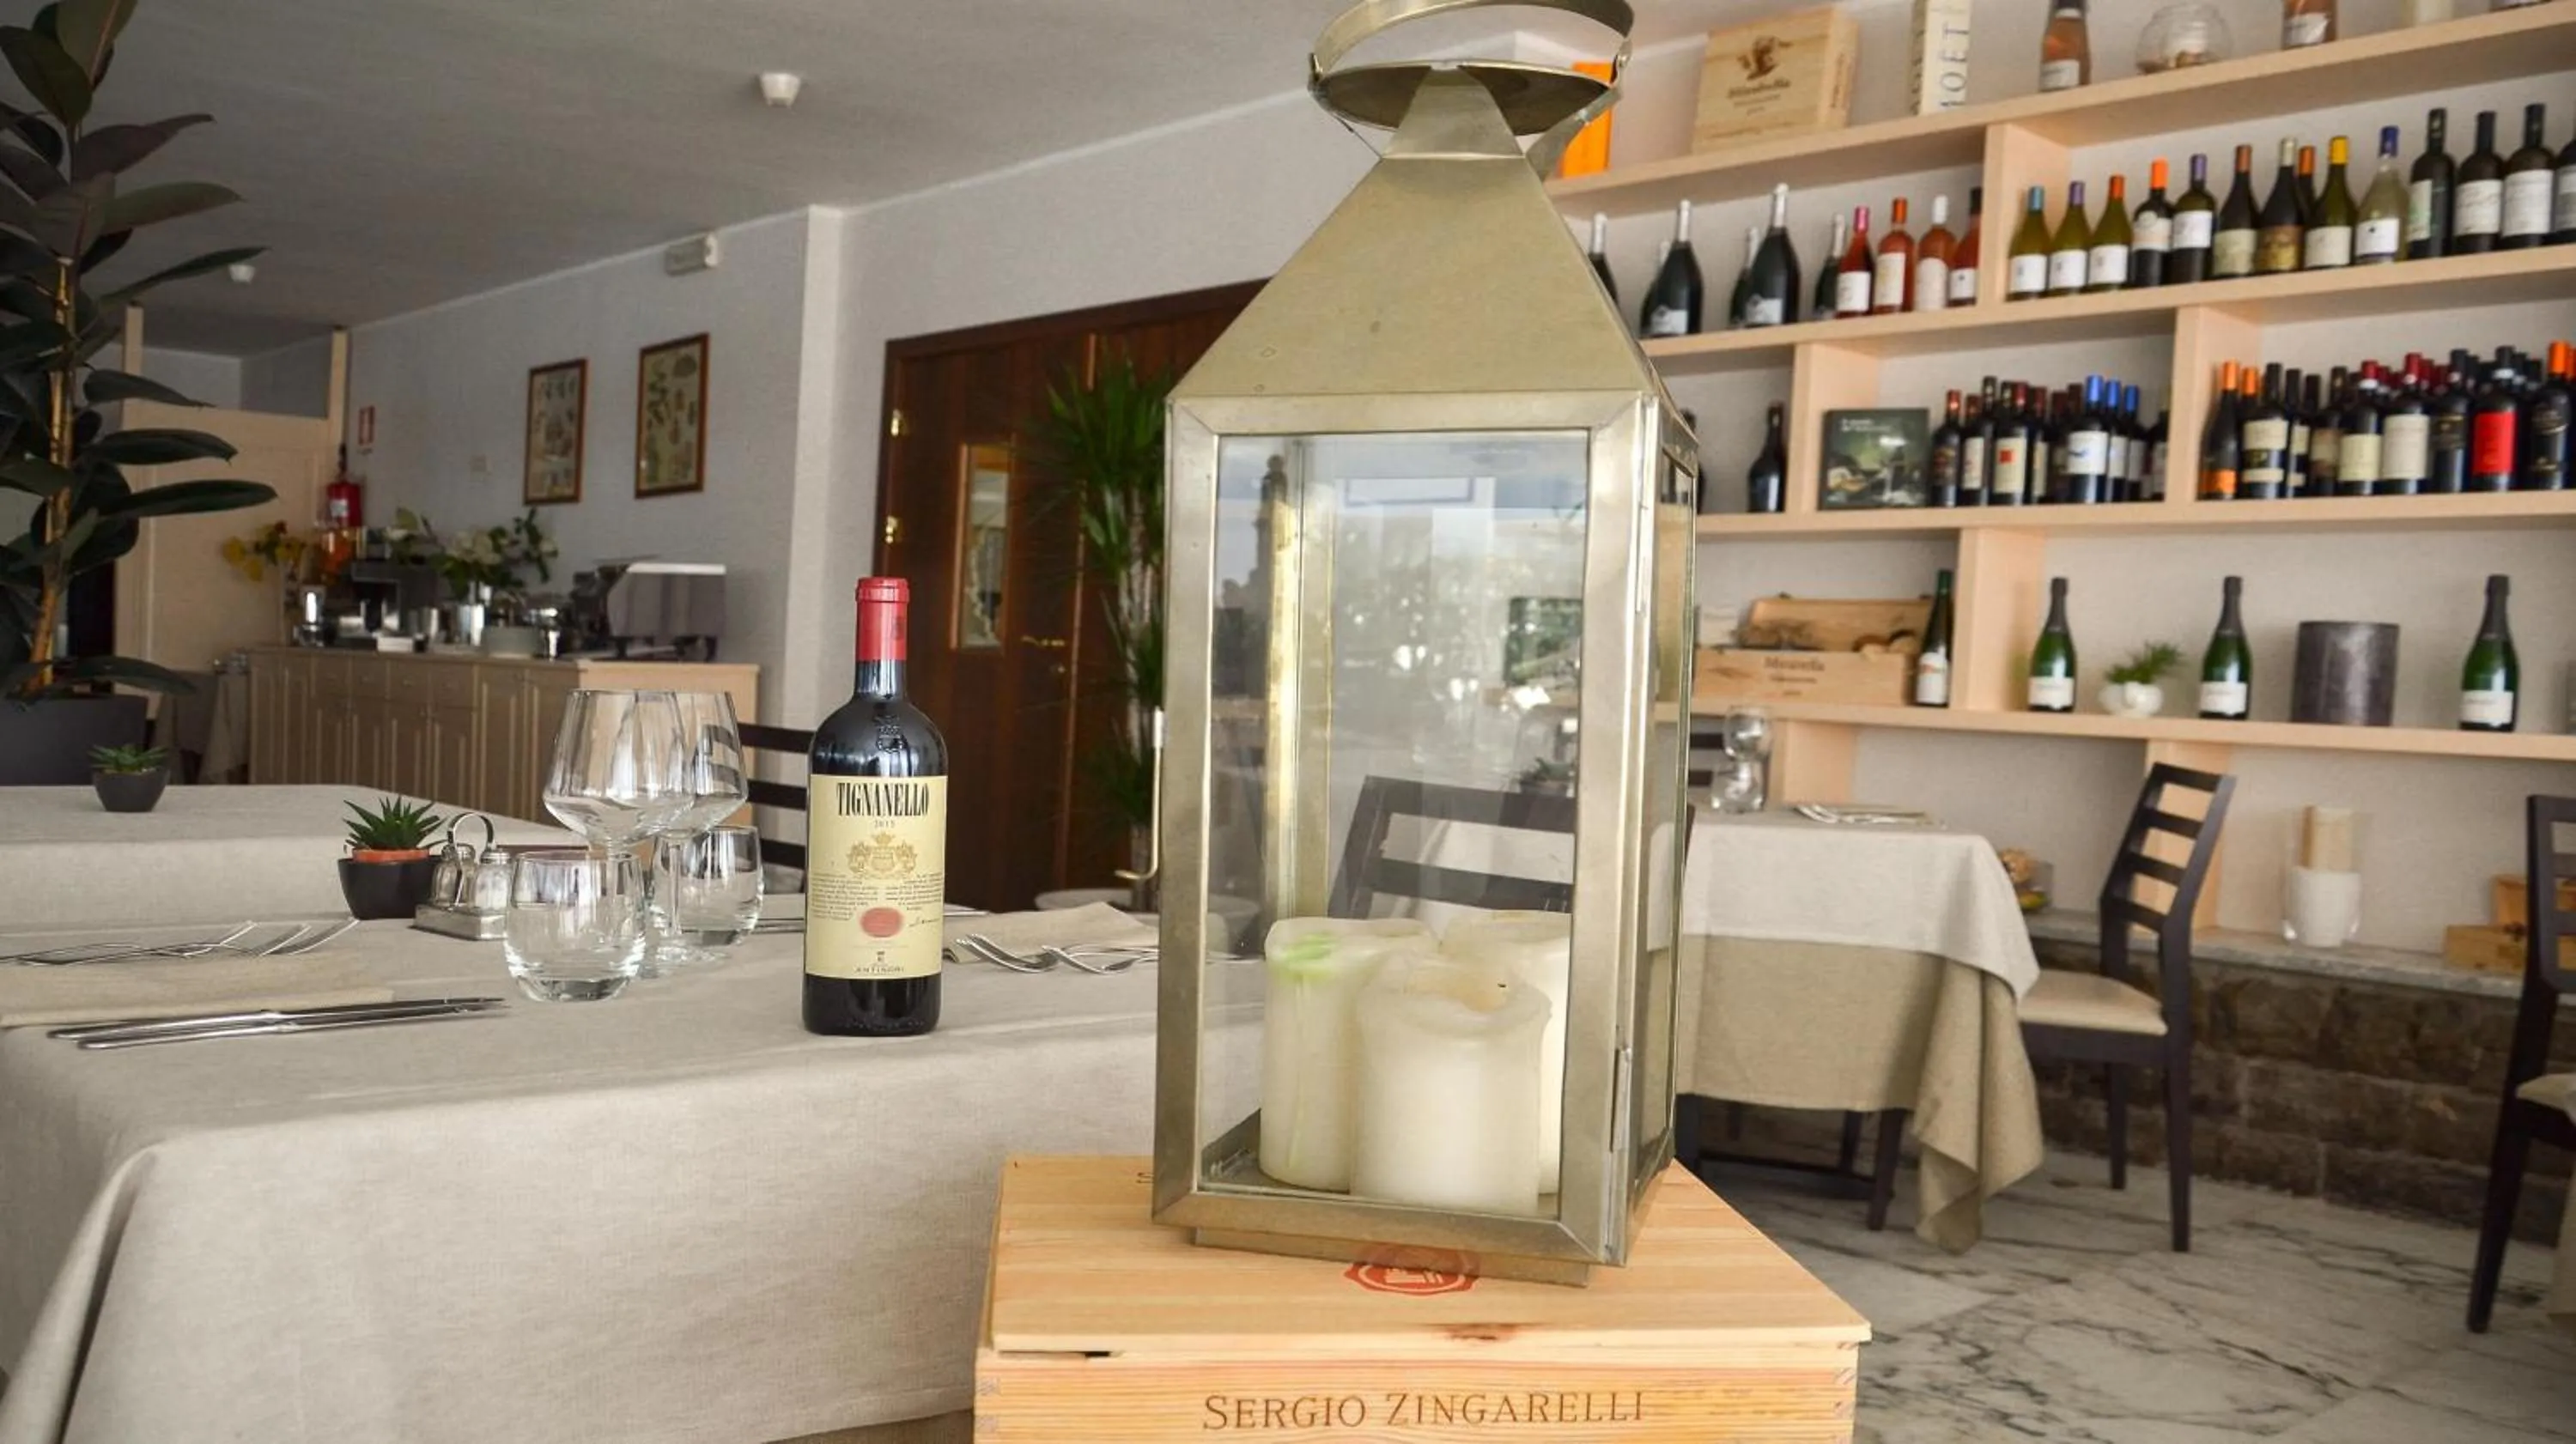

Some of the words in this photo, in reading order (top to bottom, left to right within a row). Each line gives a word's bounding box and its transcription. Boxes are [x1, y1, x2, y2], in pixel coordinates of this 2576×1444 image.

[1940, 21, 1970, 107] OET
[836, 782, 929, 816] TIGNANELLO
[1202, 1394, 1366, 1430] SERGIO
[1386, 1390, 1643, 1426] ZINGARELLI
